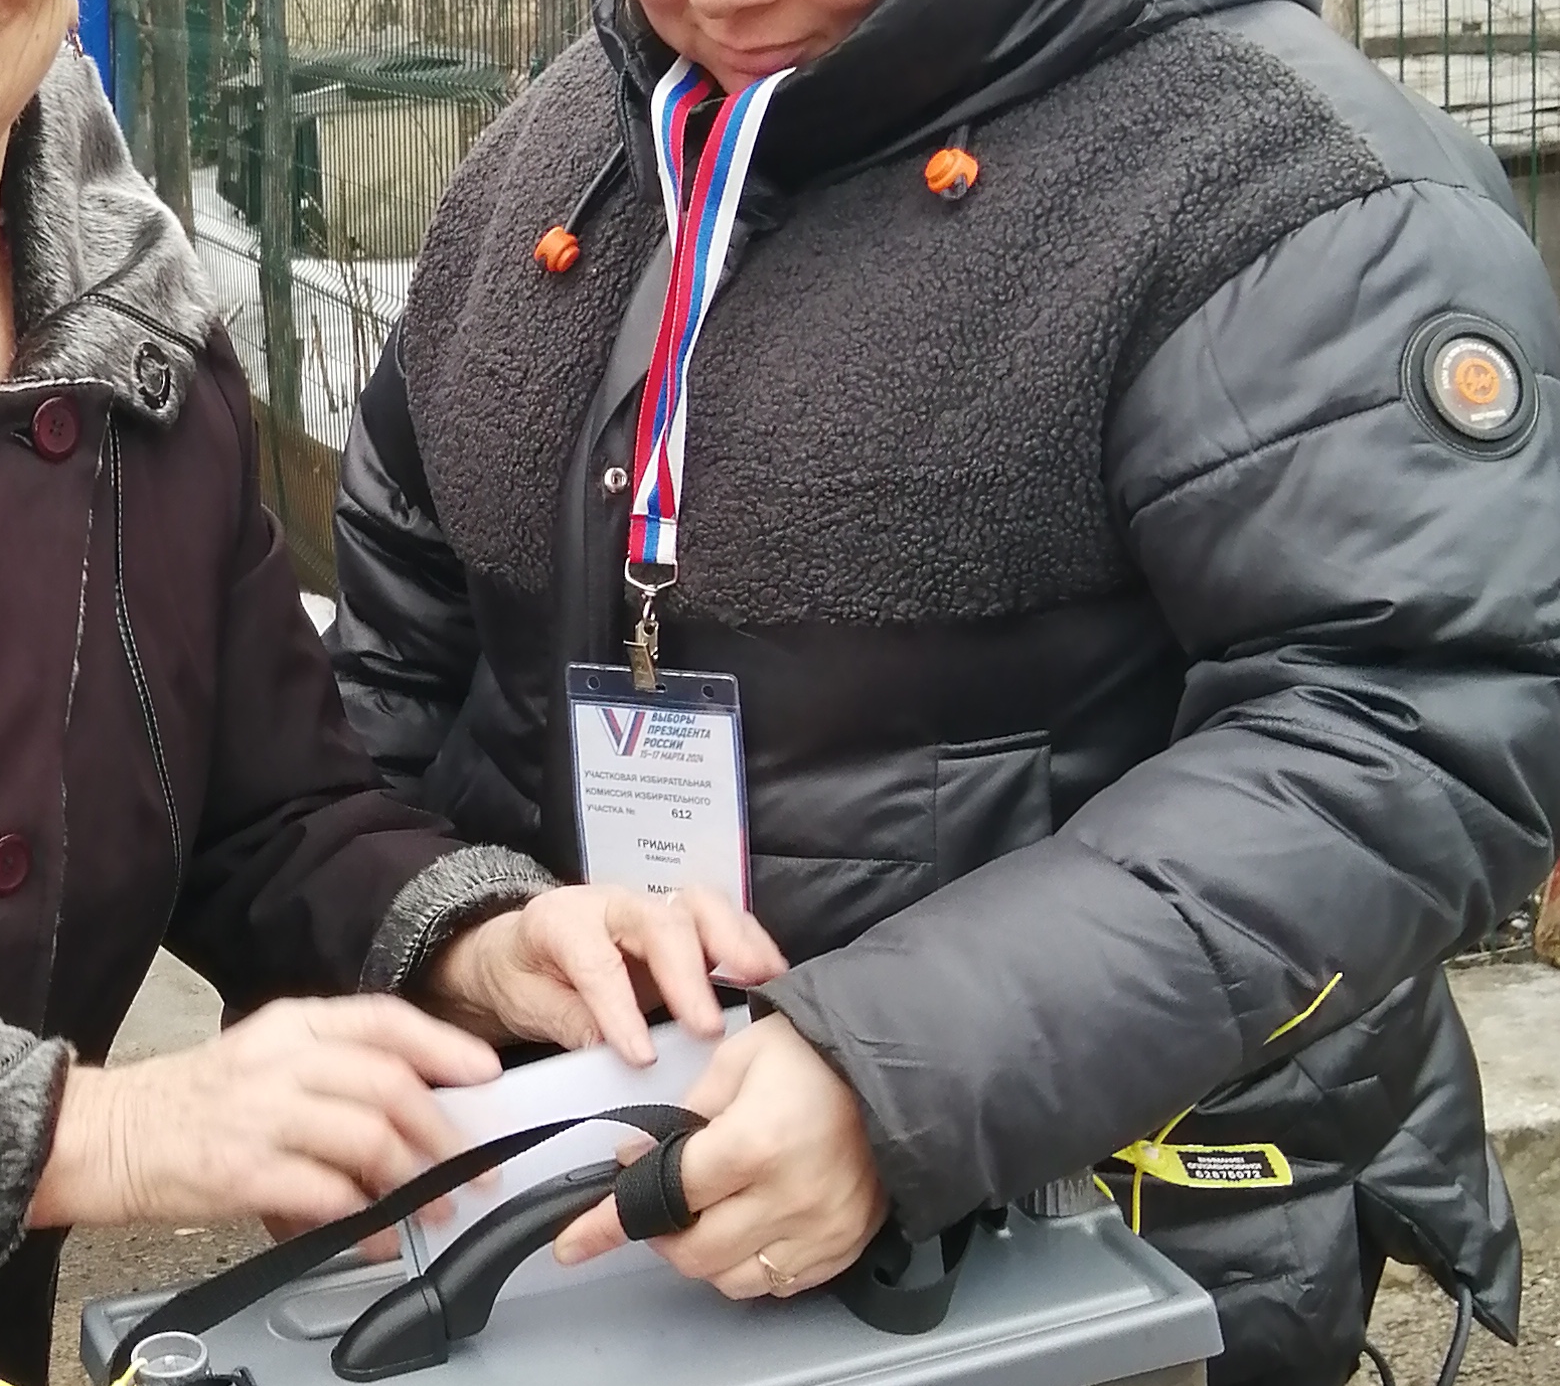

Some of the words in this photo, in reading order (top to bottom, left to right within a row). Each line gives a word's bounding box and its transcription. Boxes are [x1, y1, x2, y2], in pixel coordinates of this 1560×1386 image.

[651, 713, 696, 725] ВЫБОРЫ
[646, 725, 712, 739] ПРЕЗИДЕНТА
[643, 737, 684, 750] РОССИИ
[660, 752, 685, 762] МАРТА
[685, 753, 704, 763] 2024
[584, 770, 637, 782] УЧАСТКОВАЯ
[639, 775, 712, 788] ИЗБИРАТЕЛЬНАЯ
[585, 787, 633, 798] КОМИССИЯ
[634, 791, 711, 806] ИЗБИРАТЕЛЬНОГО
[587, 804, 624, 814] УЧАСТКА
[671, 808, 692, 819] 612
[637, 838, 686, 852] ГРИДИНА
[645, 854, 681, 864] ФАМИЛИЯ
